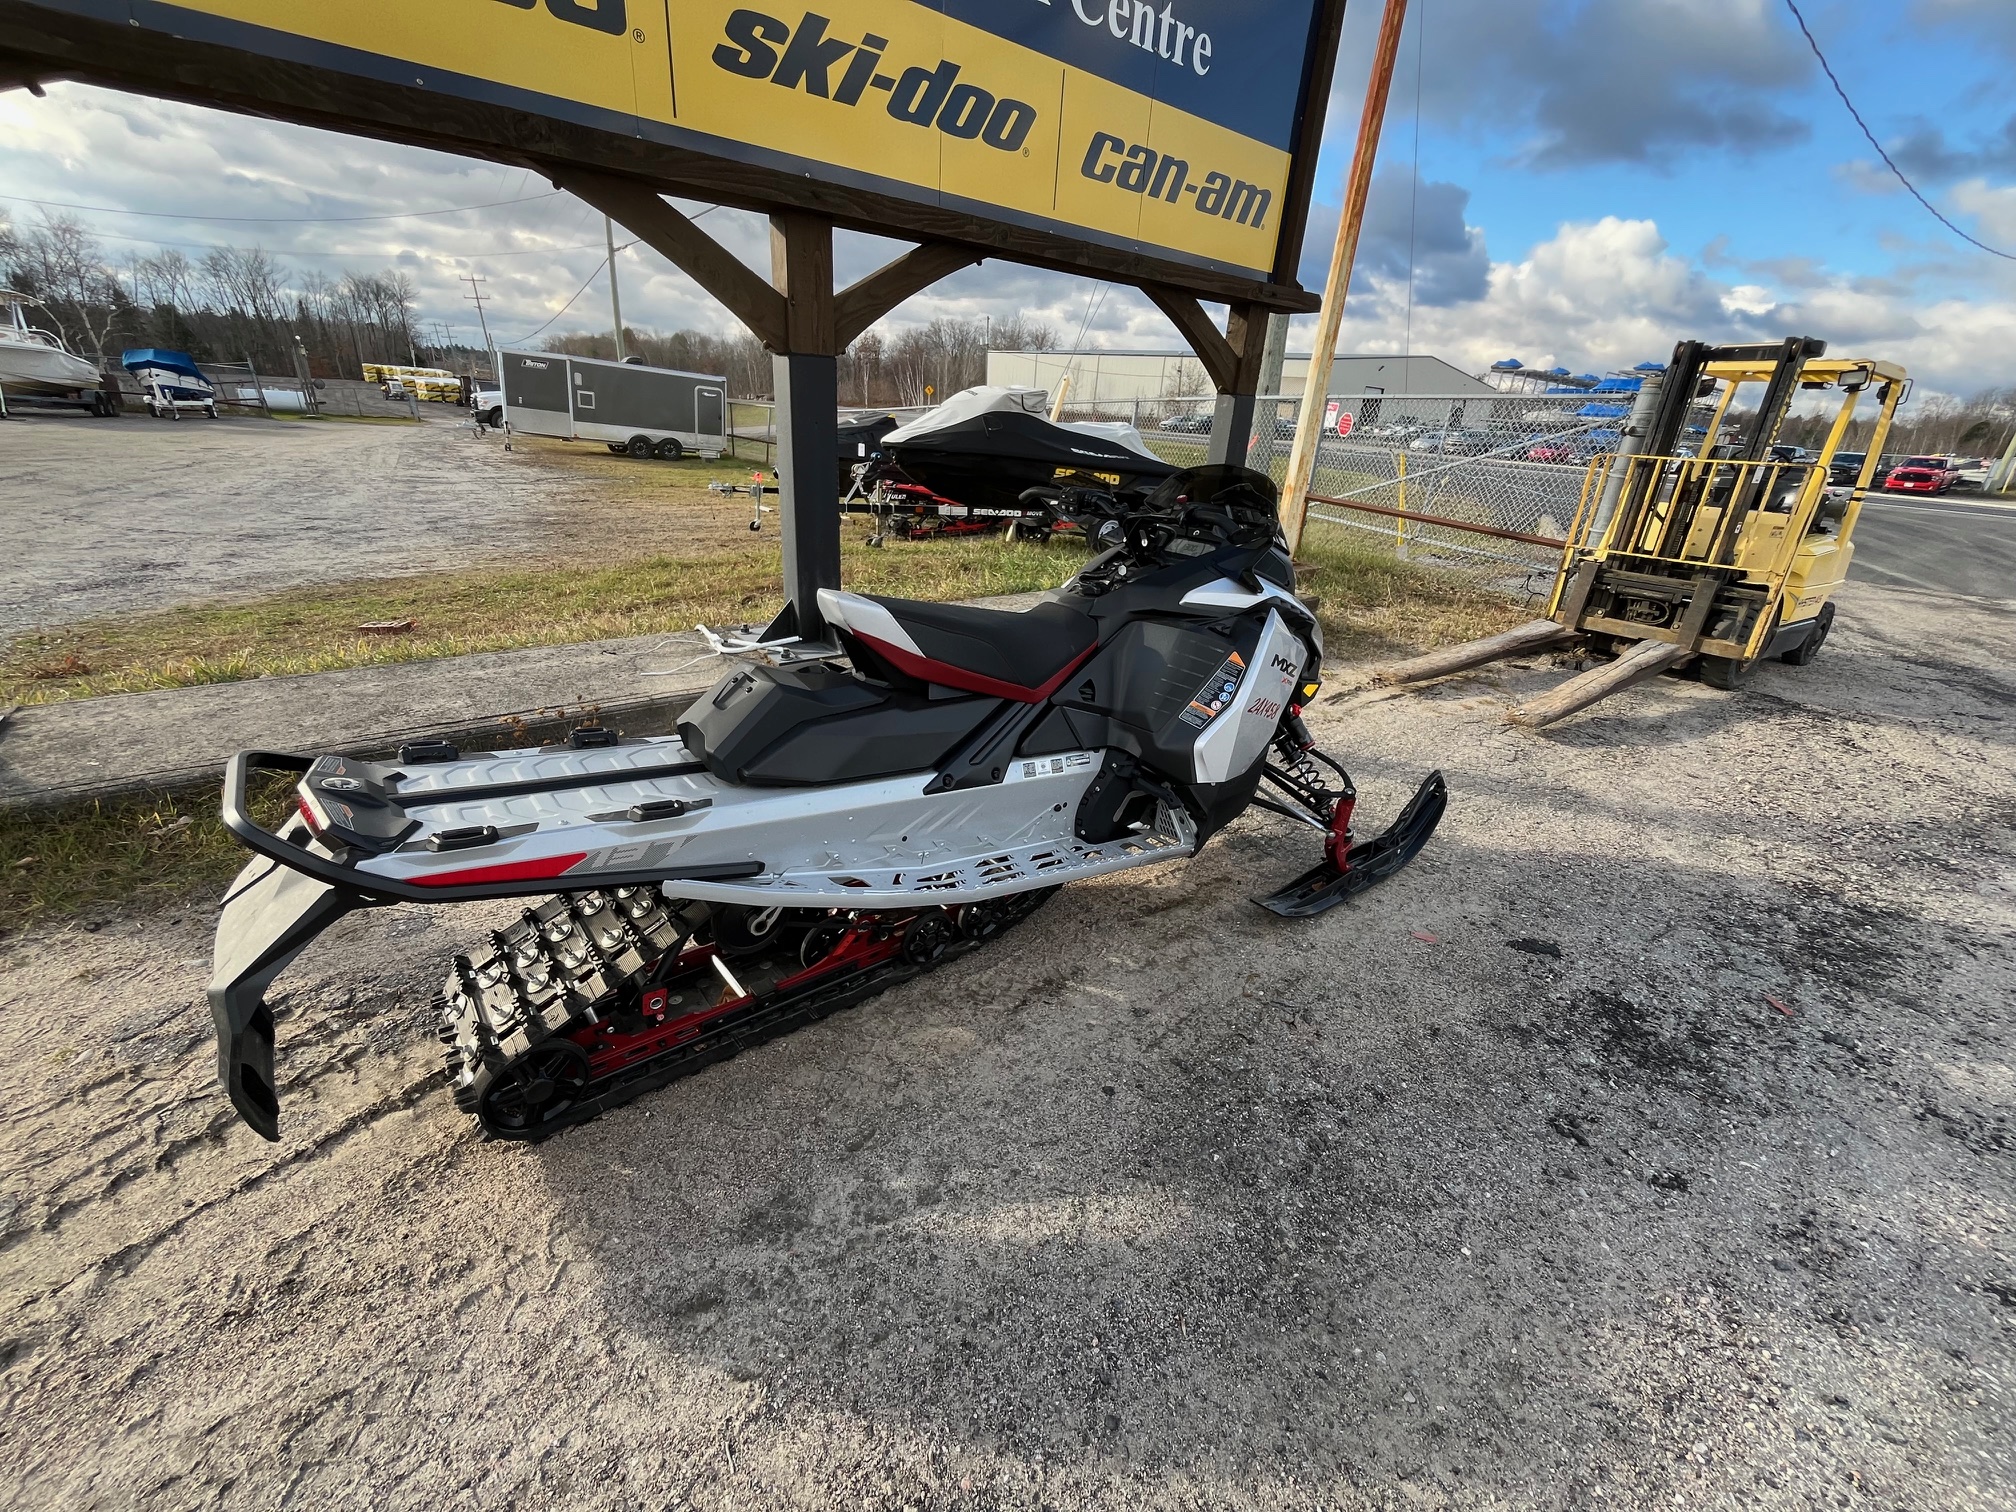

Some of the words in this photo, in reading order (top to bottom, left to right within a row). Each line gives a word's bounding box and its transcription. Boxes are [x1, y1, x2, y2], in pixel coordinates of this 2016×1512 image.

[711, 9, 1037, 152] ski-doo
[1080, 131, 1271, 229] can-am
[1270, 653, 1298, 678] MXZ
